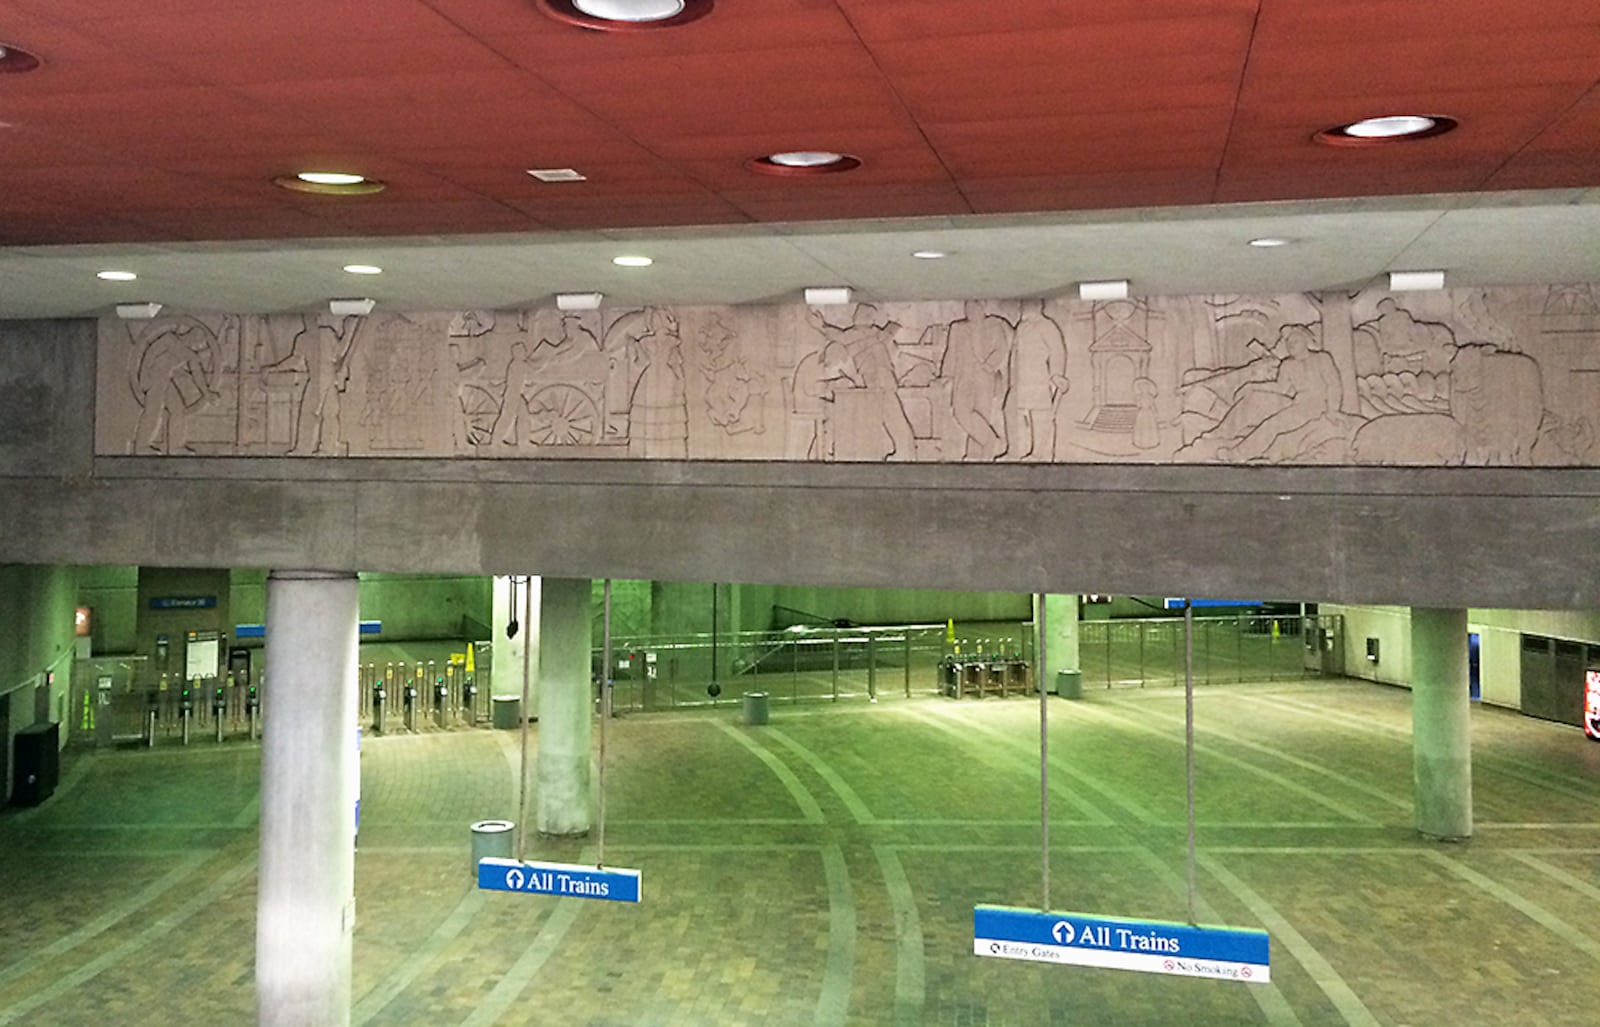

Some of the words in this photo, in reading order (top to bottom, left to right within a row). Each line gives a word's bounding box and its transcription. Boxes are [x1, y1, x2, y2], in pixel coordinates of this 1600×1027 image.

[527, 873, 553, 891] All
[557, 875, 609, 896] Trains
[1079, 925, 1111, 946] All
[1116, 929, 1180, 953] Trains
[1177, 962, 1193, 972] No
[1194, 963, 1239, 978] Smoking
